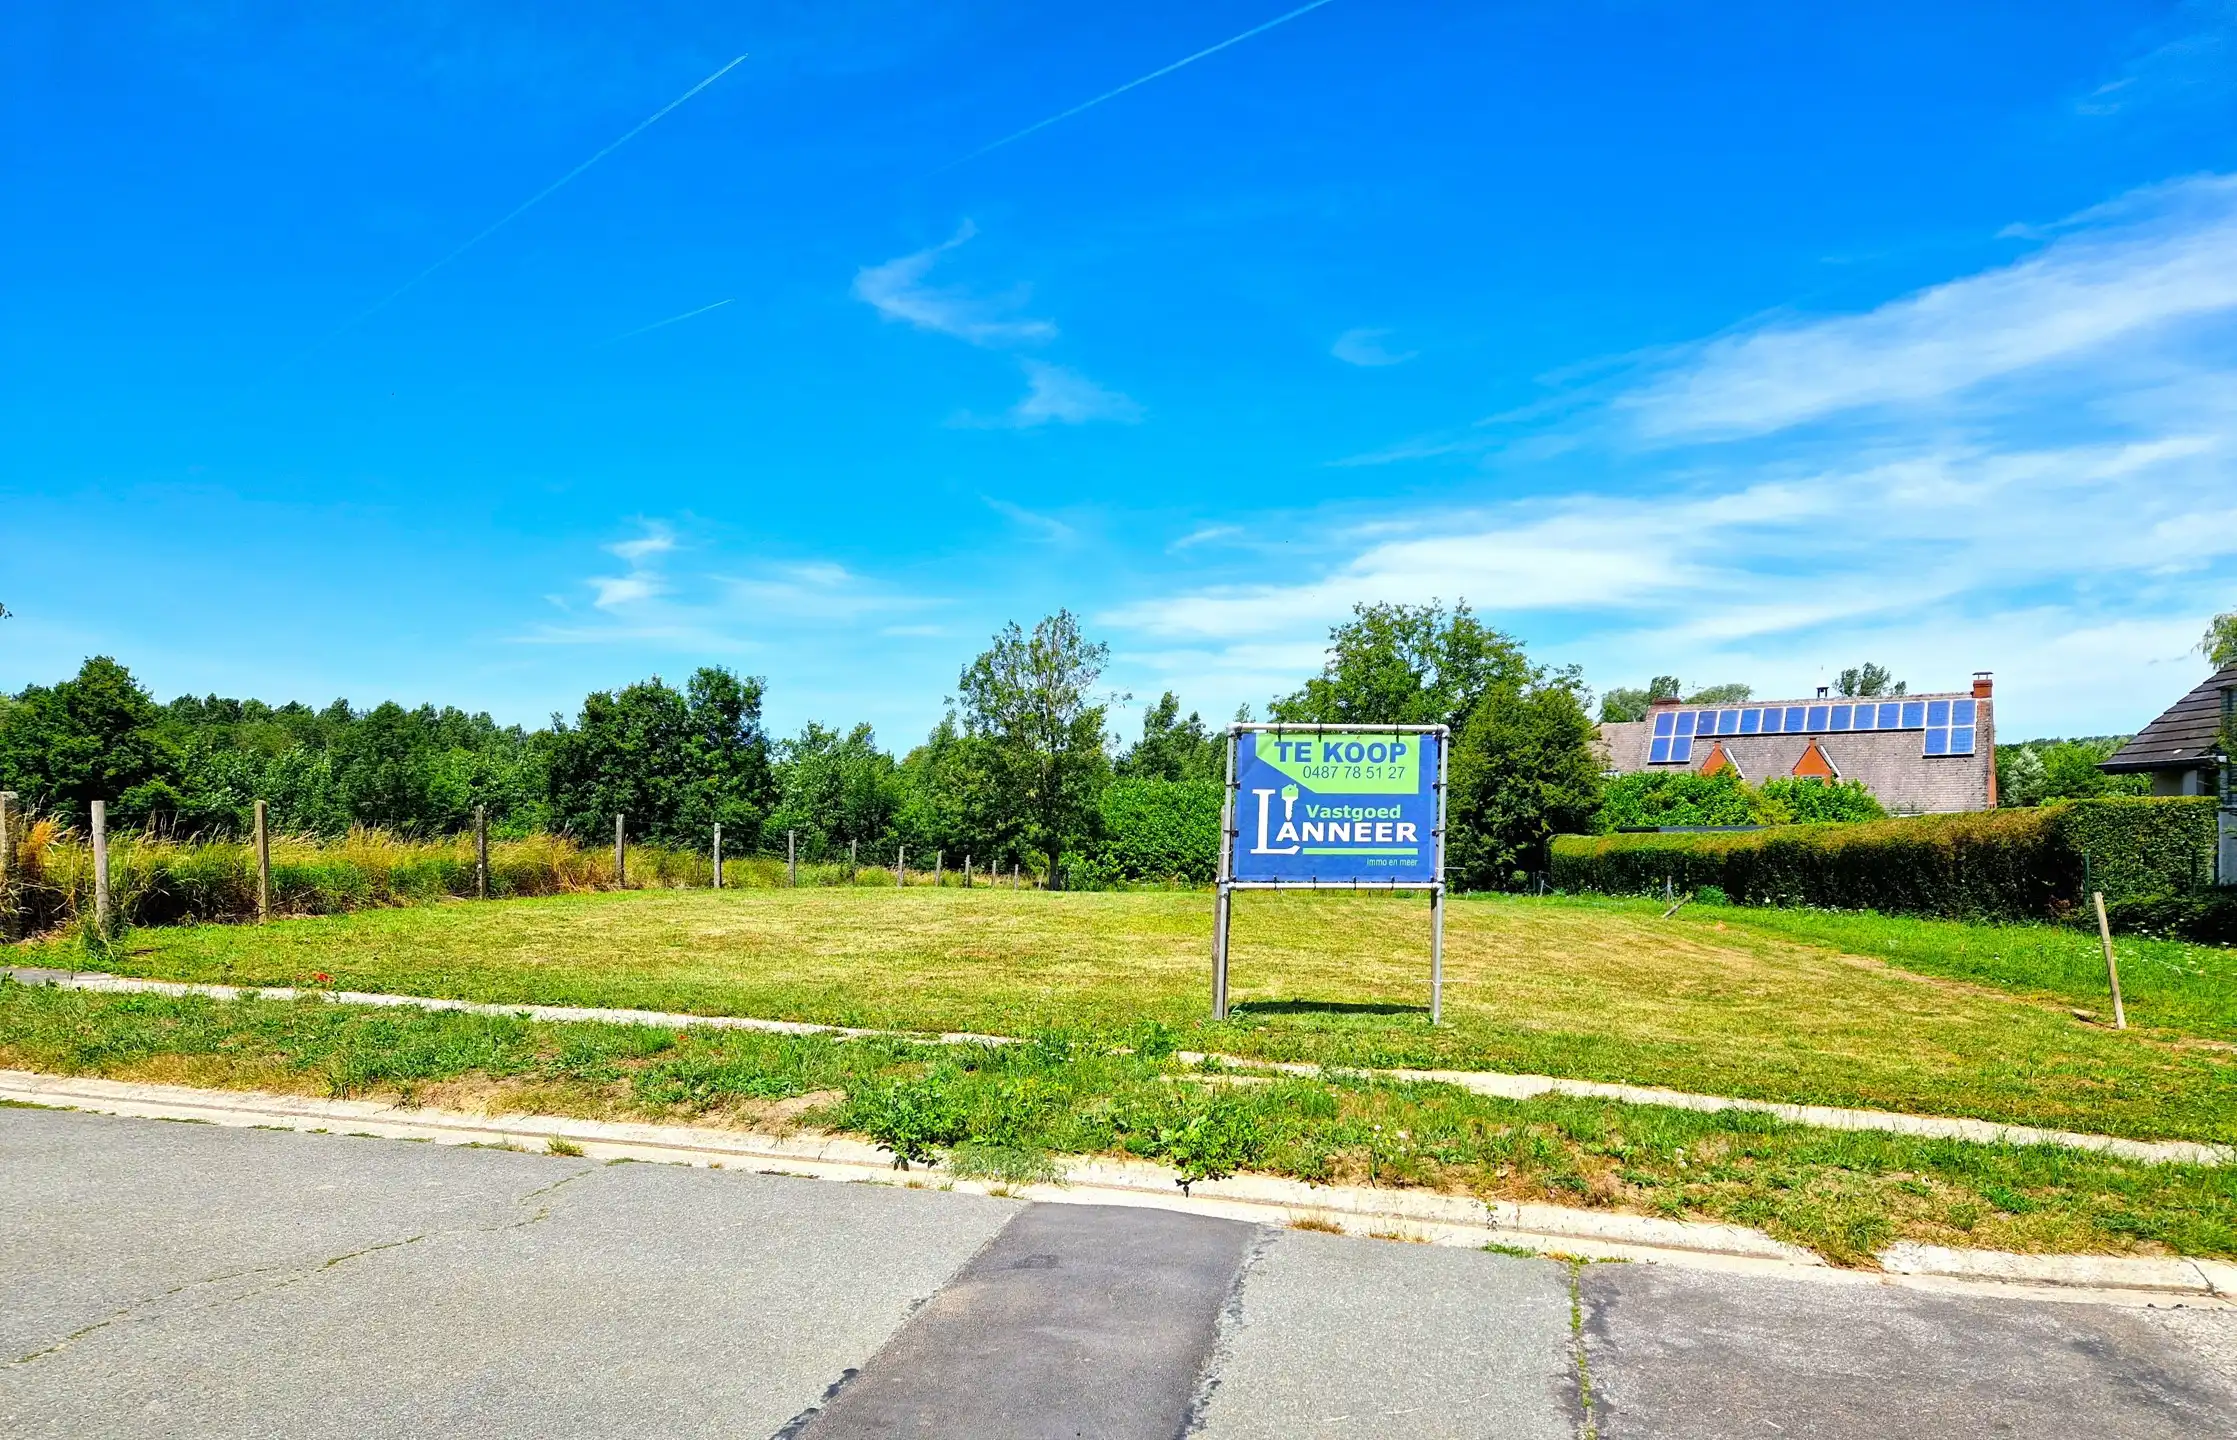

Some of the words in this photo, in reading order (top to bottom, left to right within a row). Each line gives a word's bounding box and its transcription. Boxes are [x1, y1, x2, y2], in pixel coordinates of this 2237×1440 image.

[1274, 741, 1312, 763] TE
[1323, 742, 1407, 764] KOOP
[1302, 765, 1338, 779] 0487
[1344, 765, 1361, 779] 78
[1366, 765, 1382, 780] 51
[1388, 766, 1406, 779] 27
[1250, 788, 1418, 855] LANNEER
[1305, 804, 1401, 822] Vastgoed
